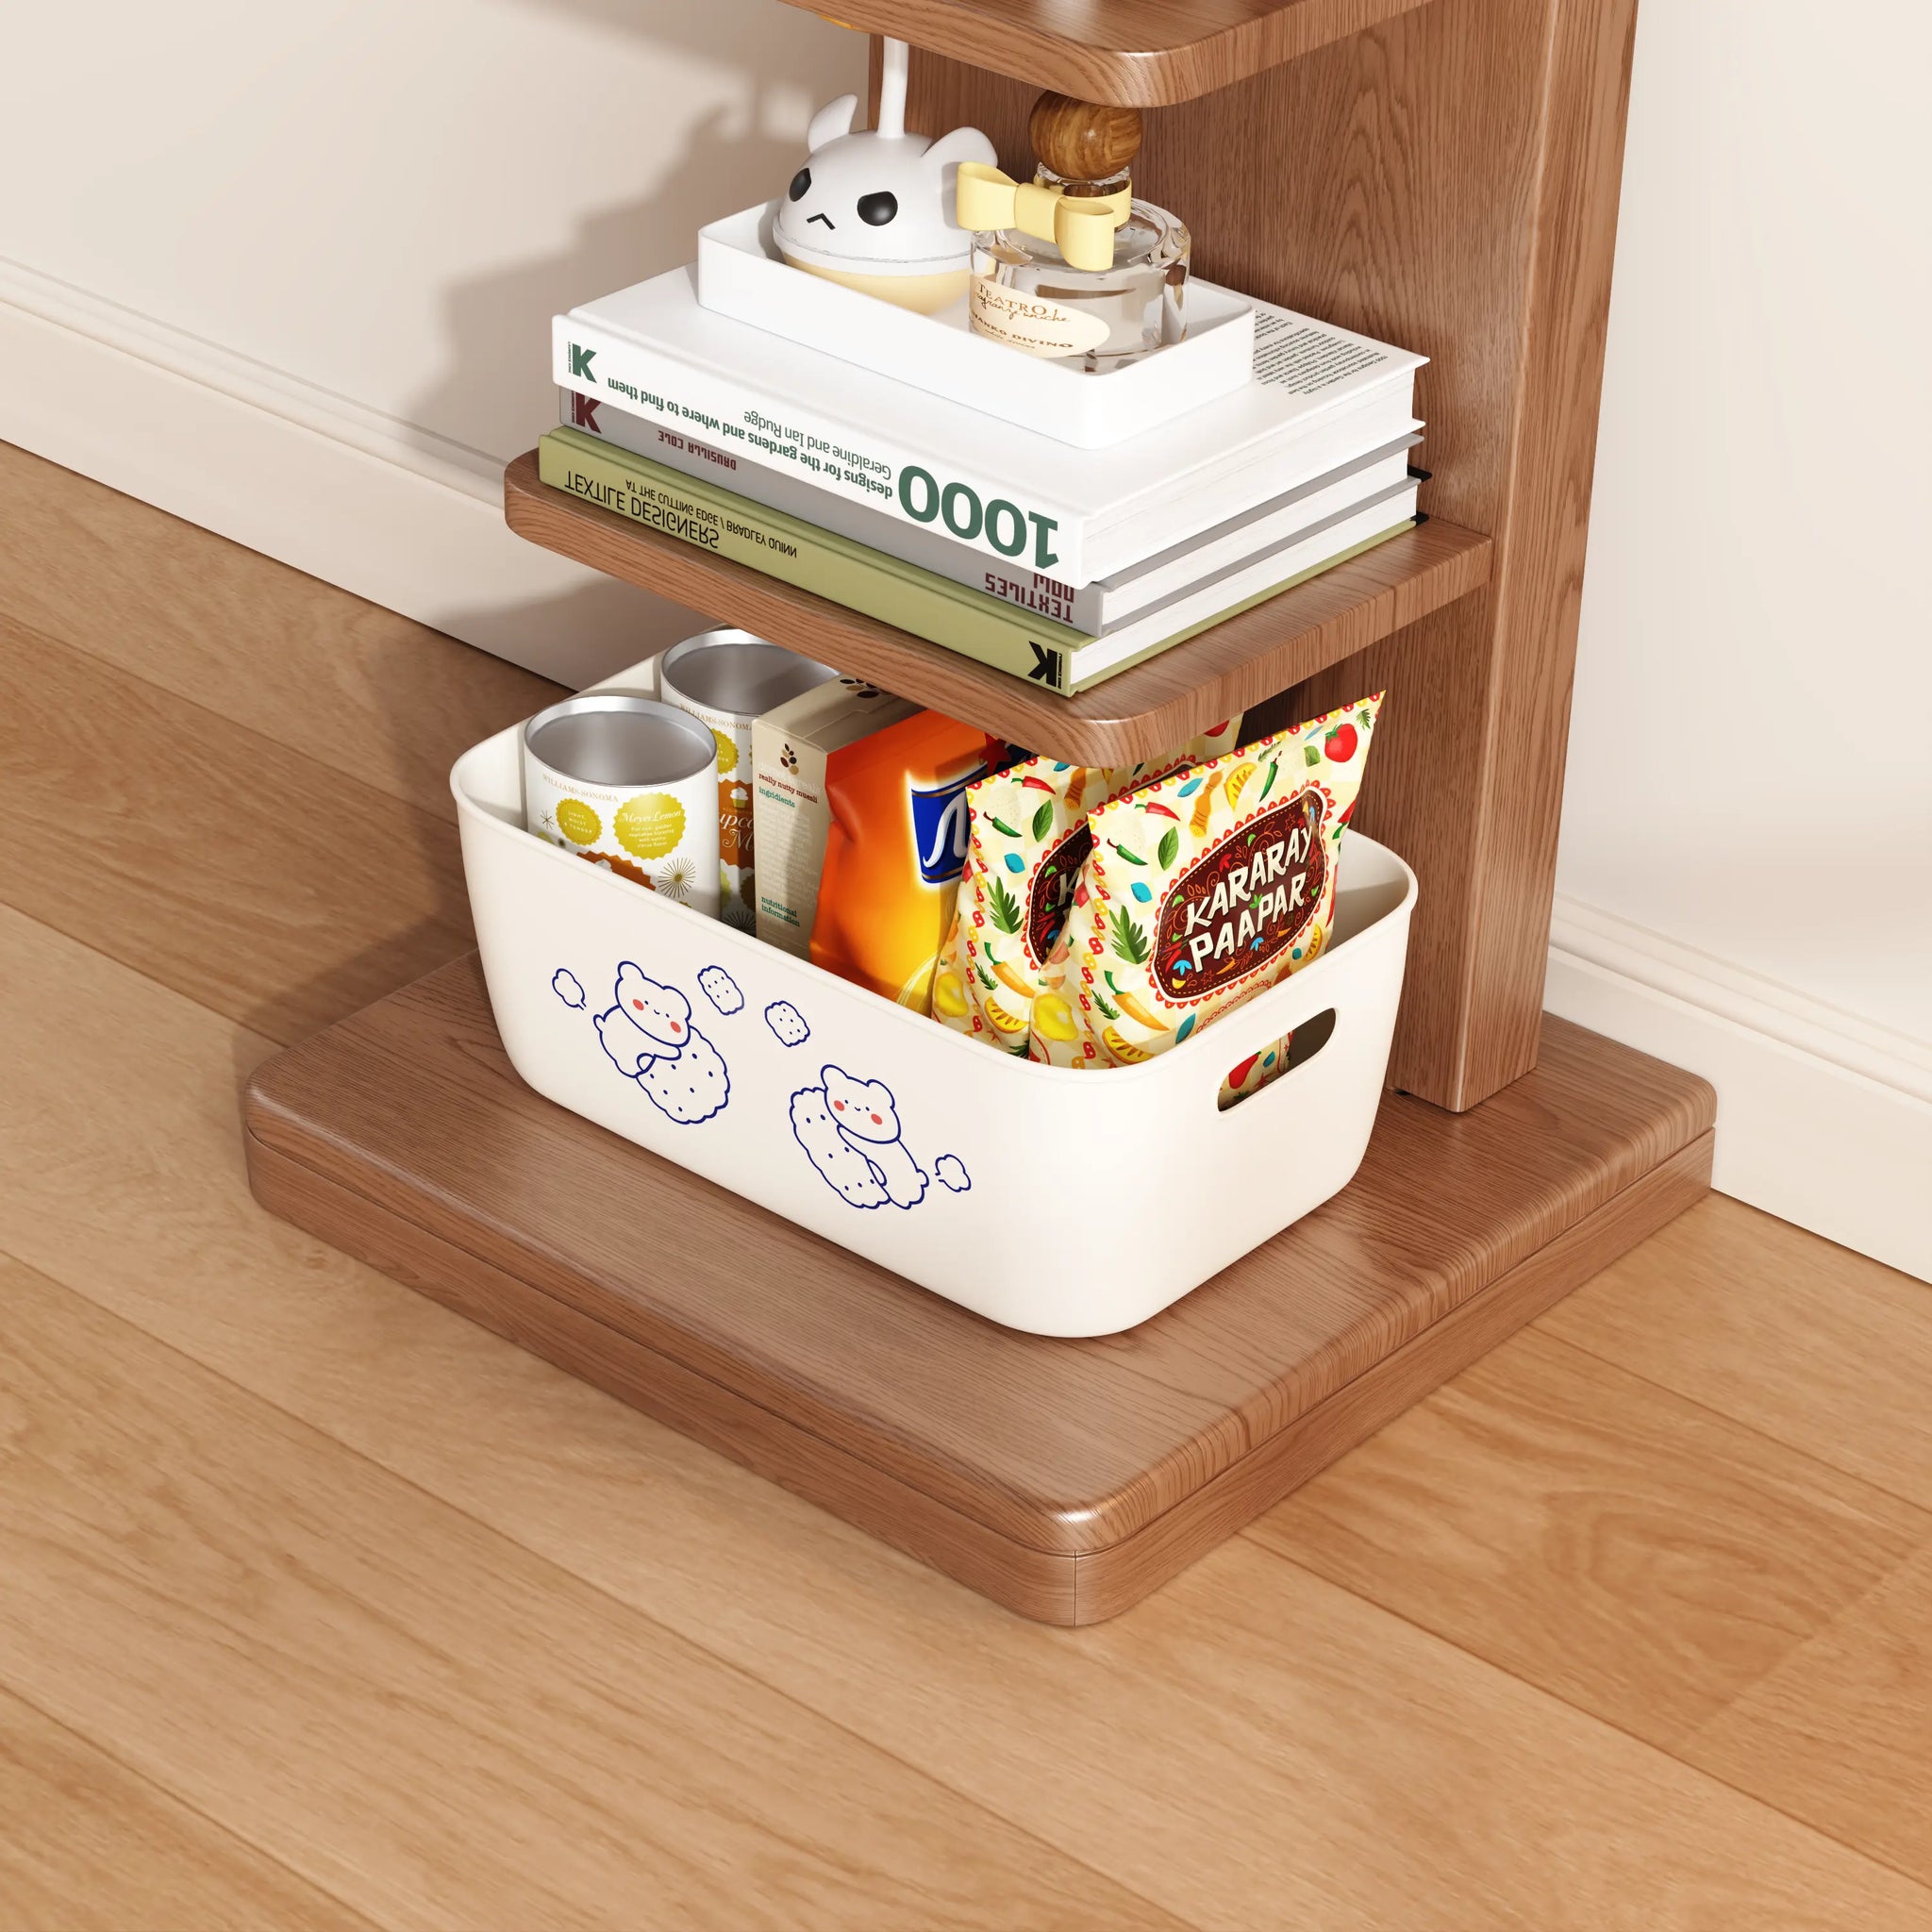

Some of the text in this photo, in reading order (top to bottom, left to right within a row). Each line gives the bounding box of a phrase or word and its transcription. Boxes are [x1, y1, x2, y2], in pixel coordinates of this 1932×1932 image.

[978, 284, 1047, 317] TEATRO
[1011, 333, 1074, 347] DIVINO
[572, 343, 597, 384] K
[608, 377, 892, 499] designs for the gardens and where to find them
[658, 430, 736, 471] DRUSILLA COLE
[744, 410, 891, 480] Geraldine and Ian Rudge
[896, 466, 1058, 569] 1000
[984, 573, 1073, 624] TEXTILES
[758, 773, 777, 787] really
[777, 782, 795, 794] nutty
[796, 790, 818, 804] muesli
[758, 786, 796, 808] ingridients
[651, 810, 681, 823] Lemon
[1184, 826, 1312, 937] KARARAY
[761, 897, 797, 918] nutritional
[761, 904, 800, 927] information
[1189, 872, 1307, 973] PAAPAR
